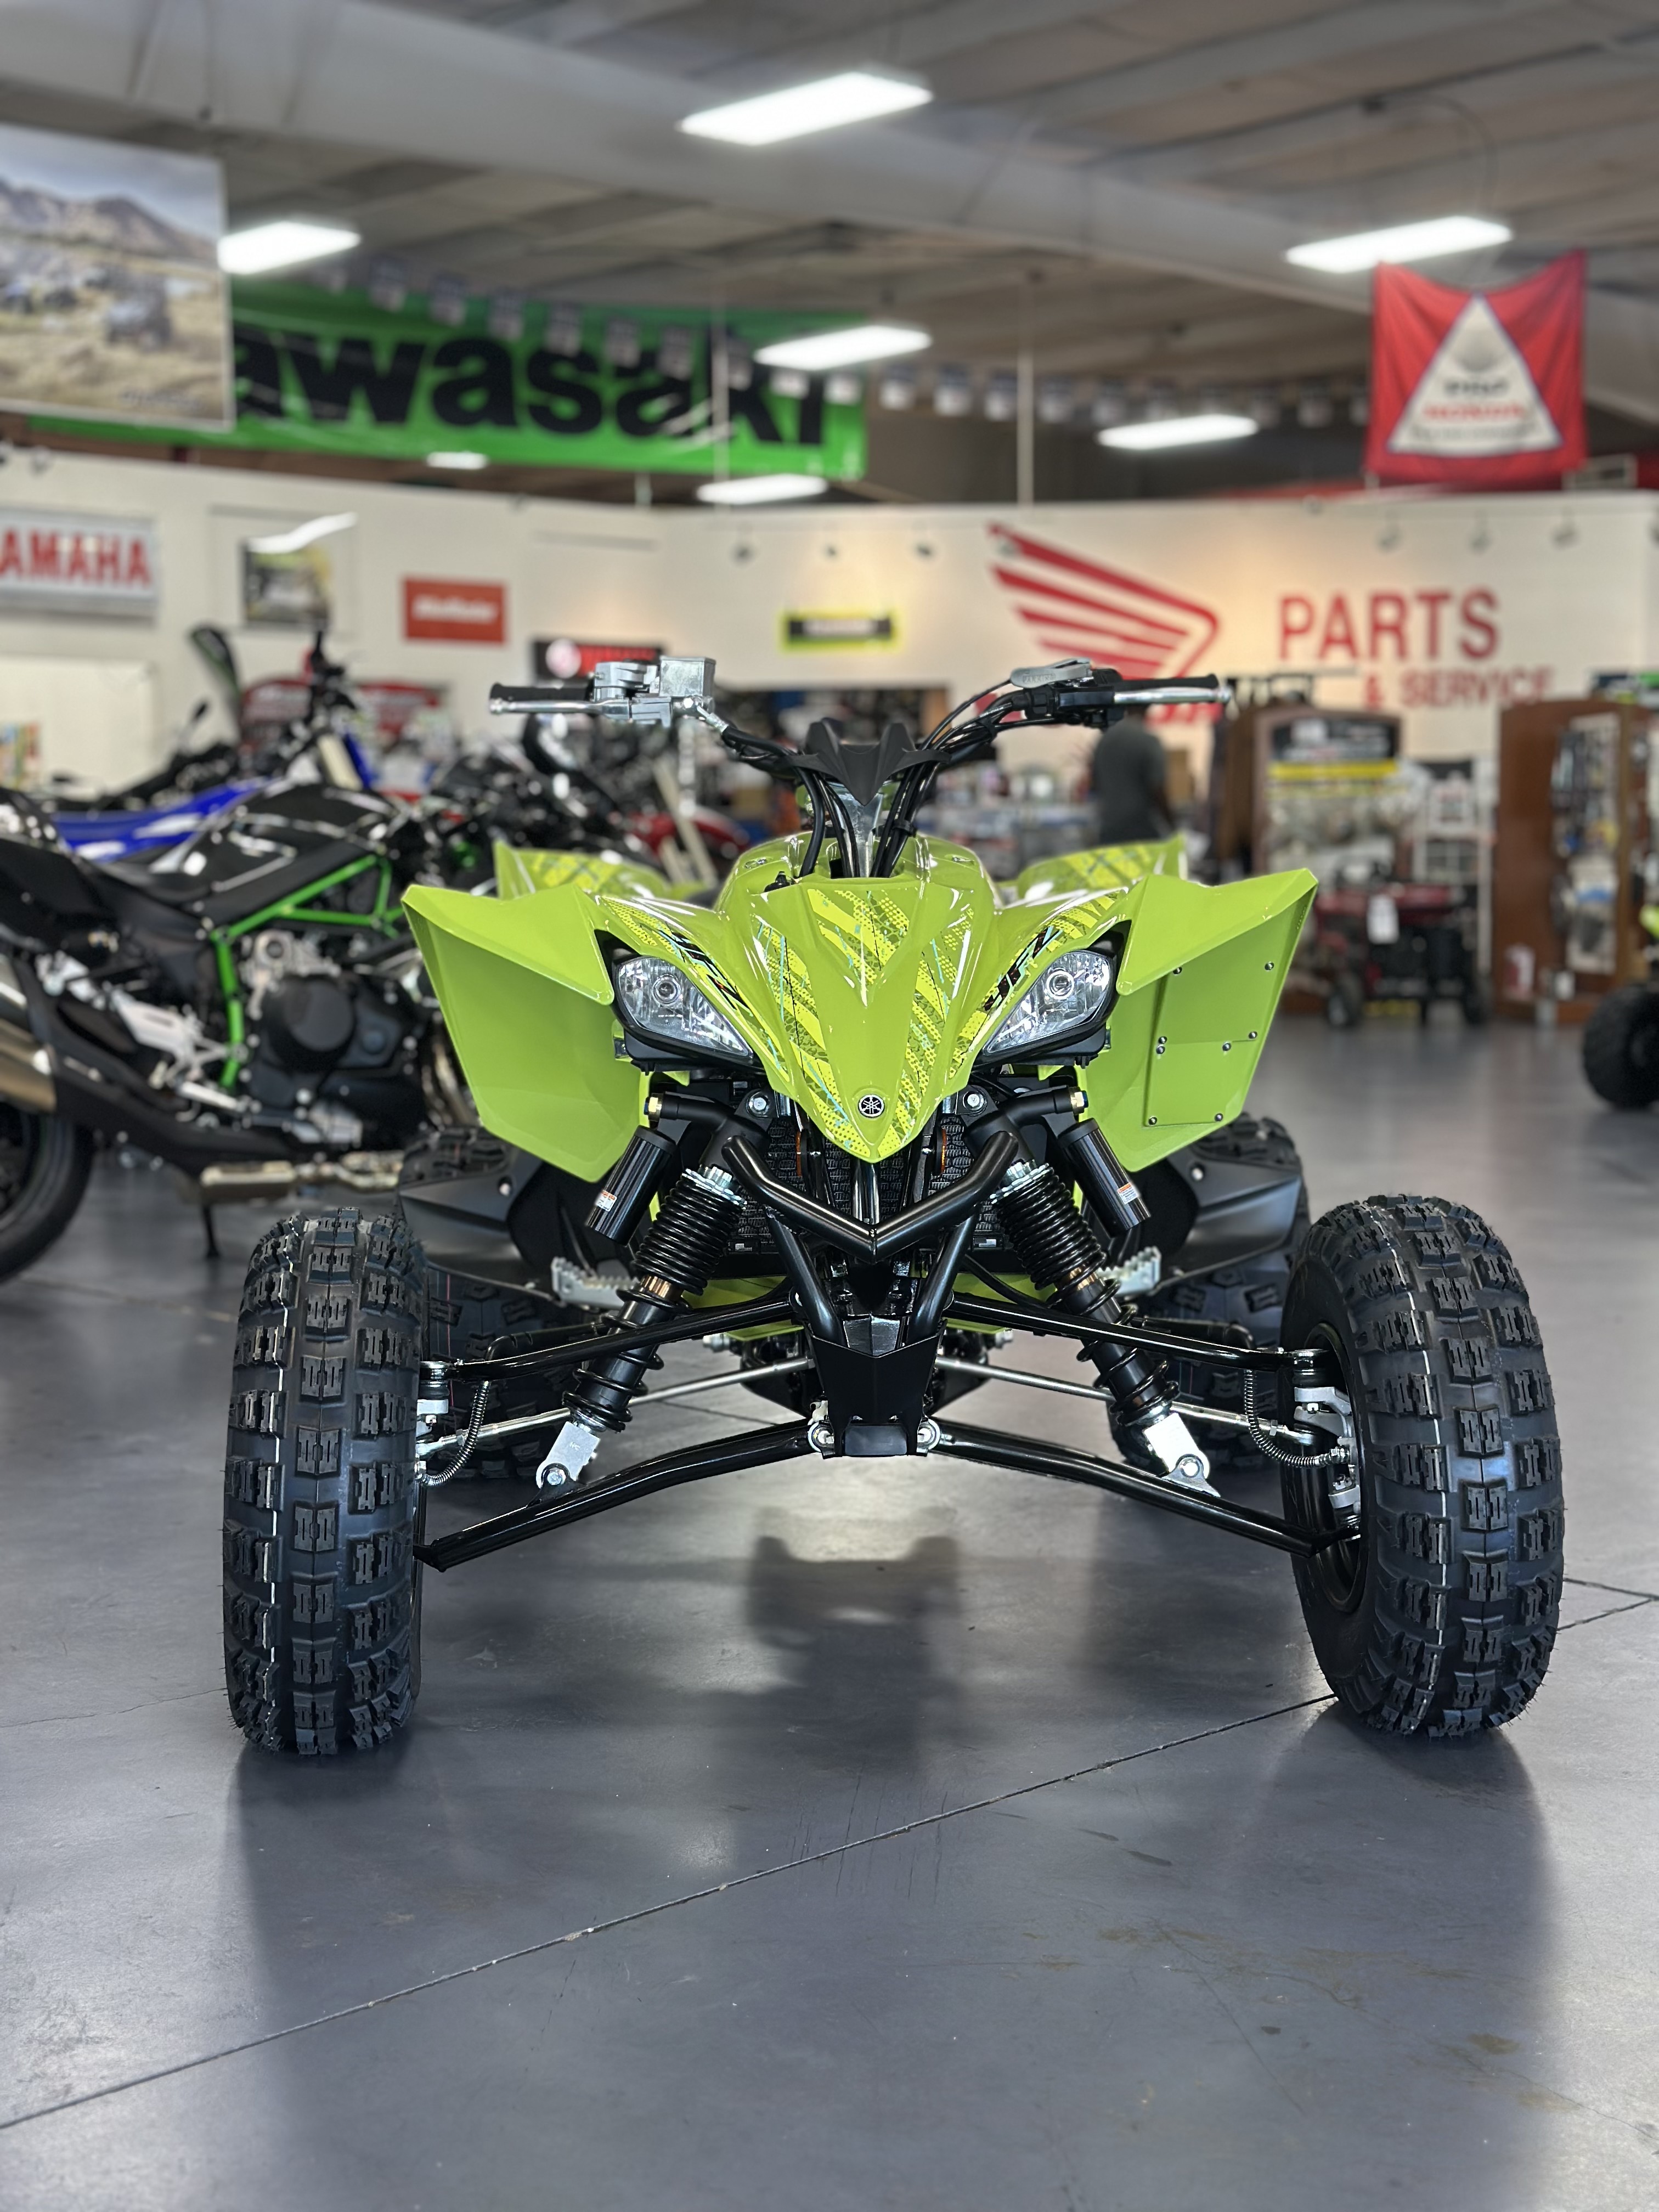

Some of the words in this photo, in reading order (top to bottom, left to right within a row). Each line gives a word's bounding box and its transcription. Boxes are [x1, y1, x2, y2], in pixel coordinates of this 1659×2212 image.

[235, 321, 824, 445] awasaki
[0, 528, 152, 589] AMAHA
[1279, 587, 1499, 662] PARTS
